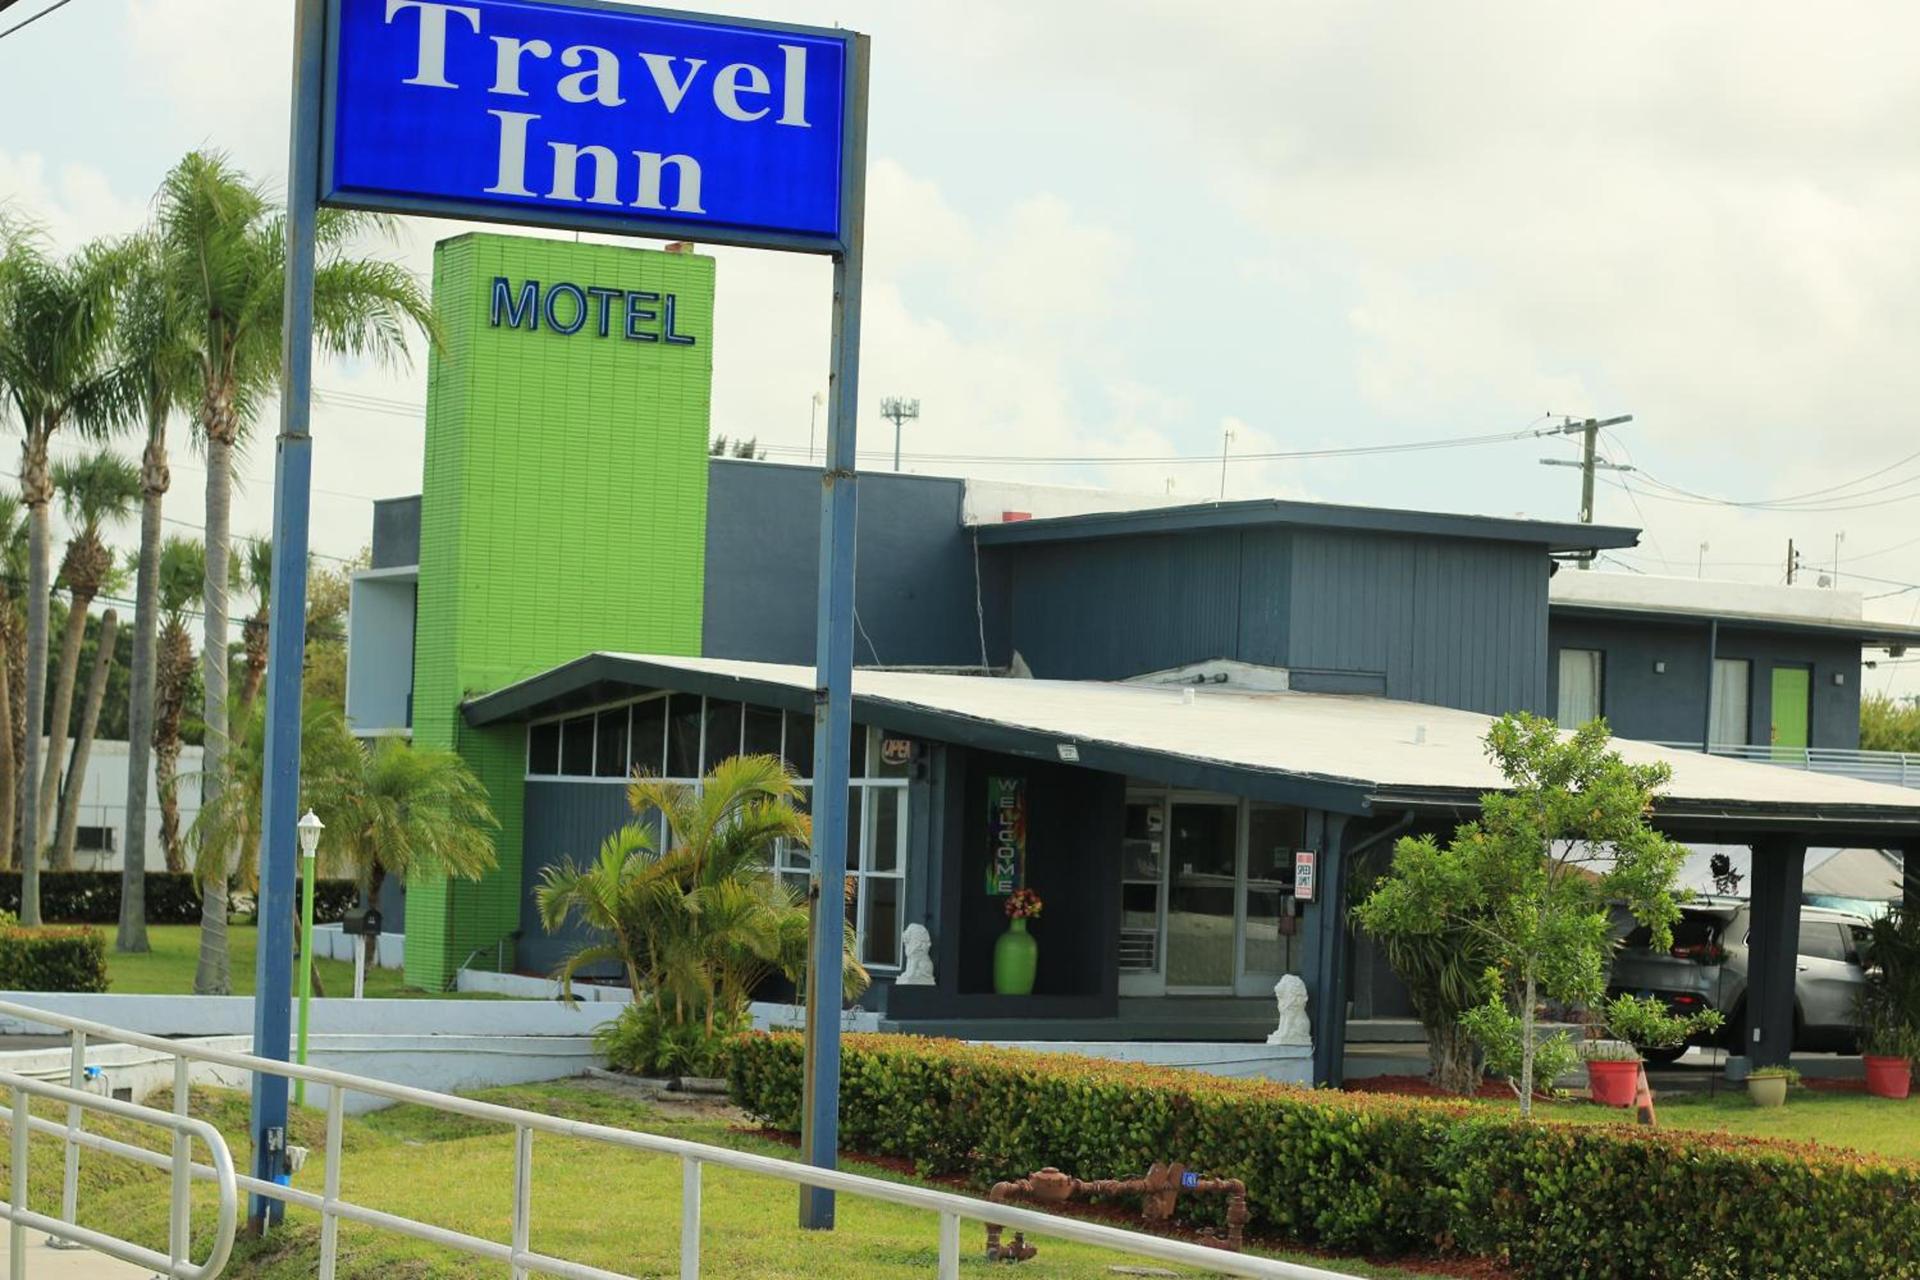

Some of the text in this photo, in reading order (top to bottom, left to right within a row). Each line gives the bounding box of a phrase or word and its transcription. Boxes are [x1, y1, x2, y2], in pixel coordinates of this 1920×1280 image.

[386, 0, 811, 127] Travel
[485, 109, 706, 214] Inn
[491, 277, 695, 345] MOTEL
[997, 778, 1017, 892] WELCOME
